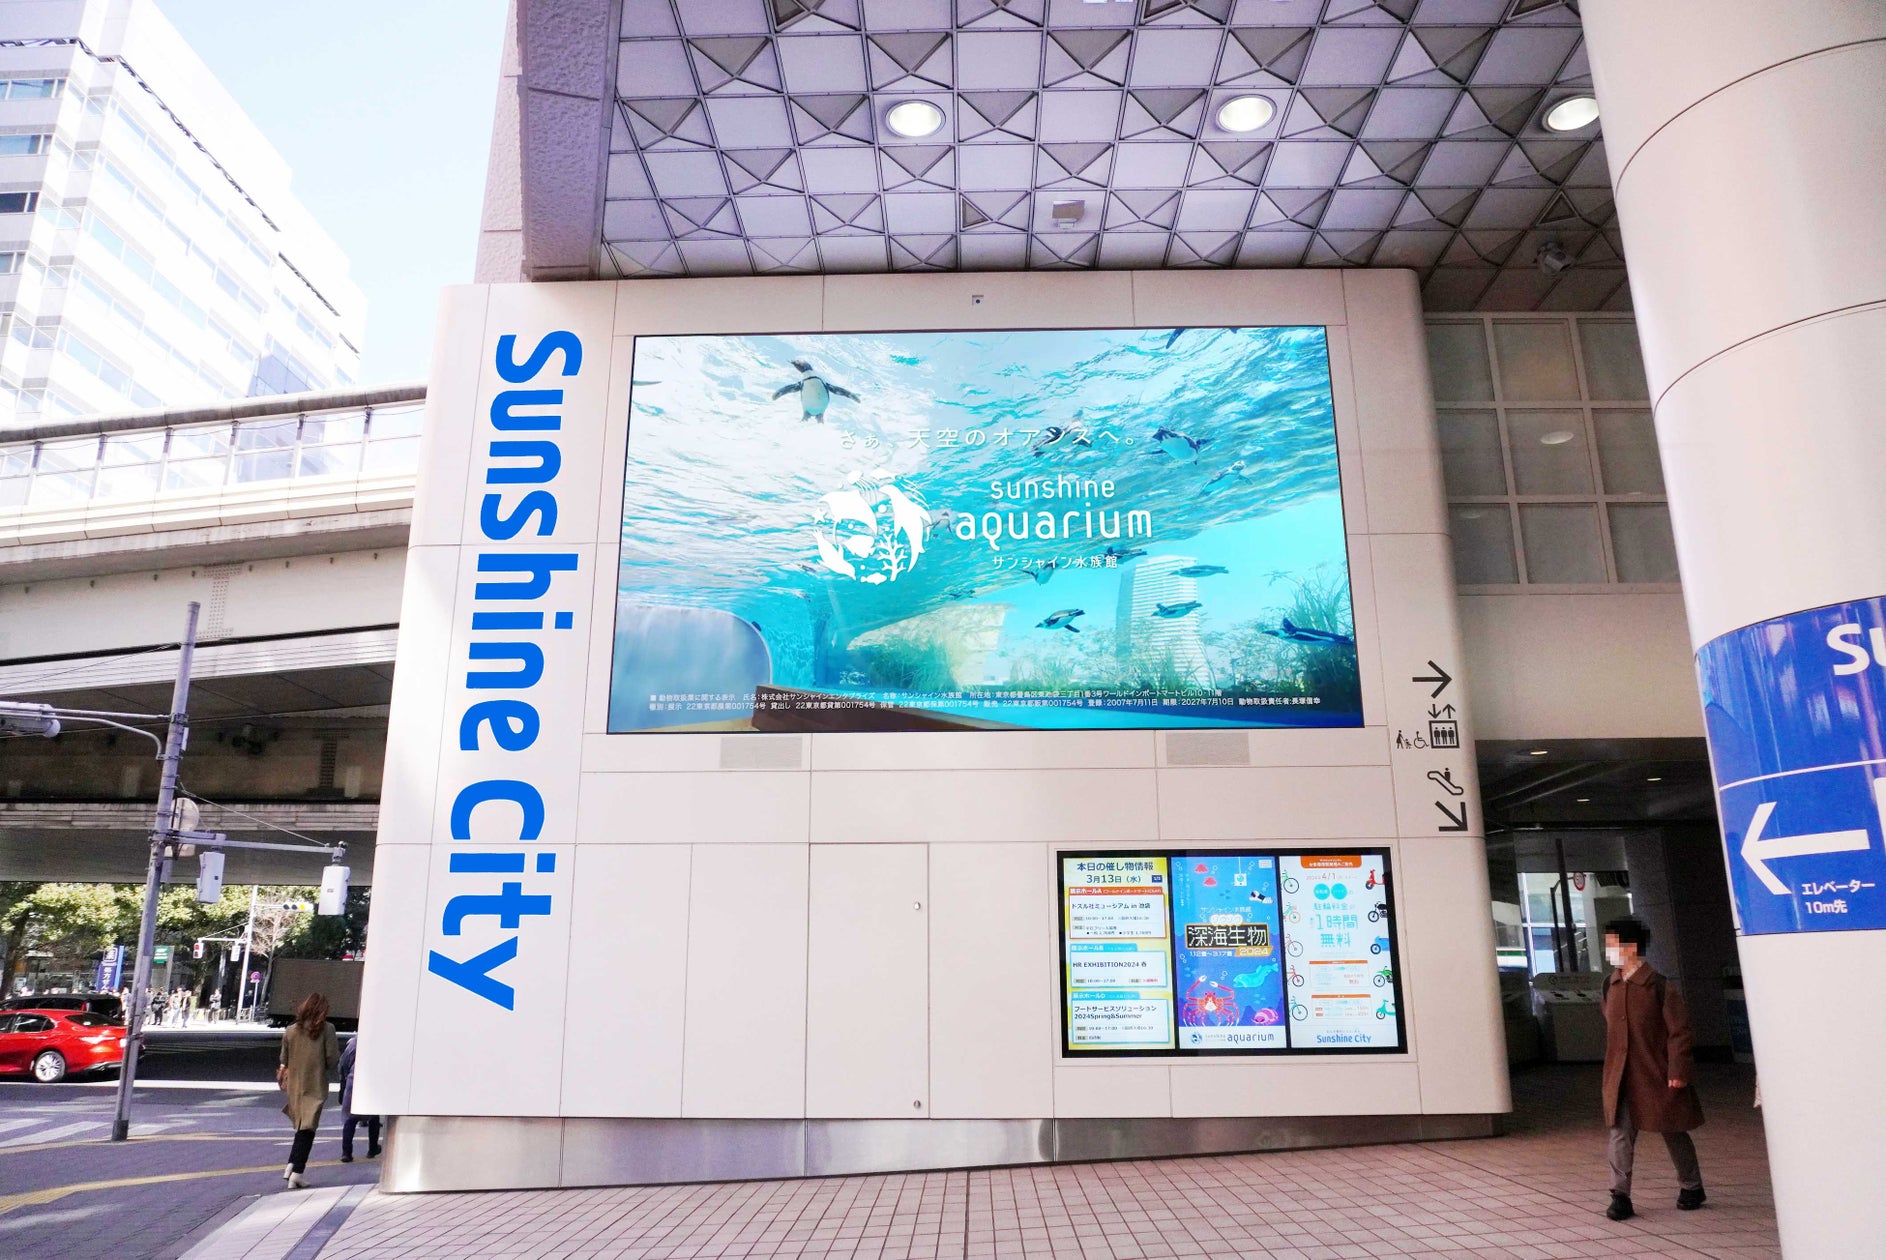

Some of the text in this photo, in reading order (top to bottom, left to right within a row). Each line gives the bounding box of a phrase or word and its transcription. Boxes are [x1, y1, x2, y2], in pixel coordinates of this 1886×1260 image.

[990, 474, 1116, 499] sunshine
[955, 502, 1153, 551] aquarium
[992, 555, 1118, 571] サンシャイン水族館
[428, 330, 583, 1012] Sunshine City
[1077, 862, 1154, 872] 本日の催し物情報
[1801, 879, 1875, 895] エレベーター
[1805, 899, 1848, 914] 10m先
[1187, 926, 1268, 946] 深海生物
[1320, 932, 1352, 948] 無料
[1239, 947, 1269, 956] 2024
[1227, 1032, 1275, 1044] aquarium
[1317, 1033, 1371, 1044] Sunshine City
